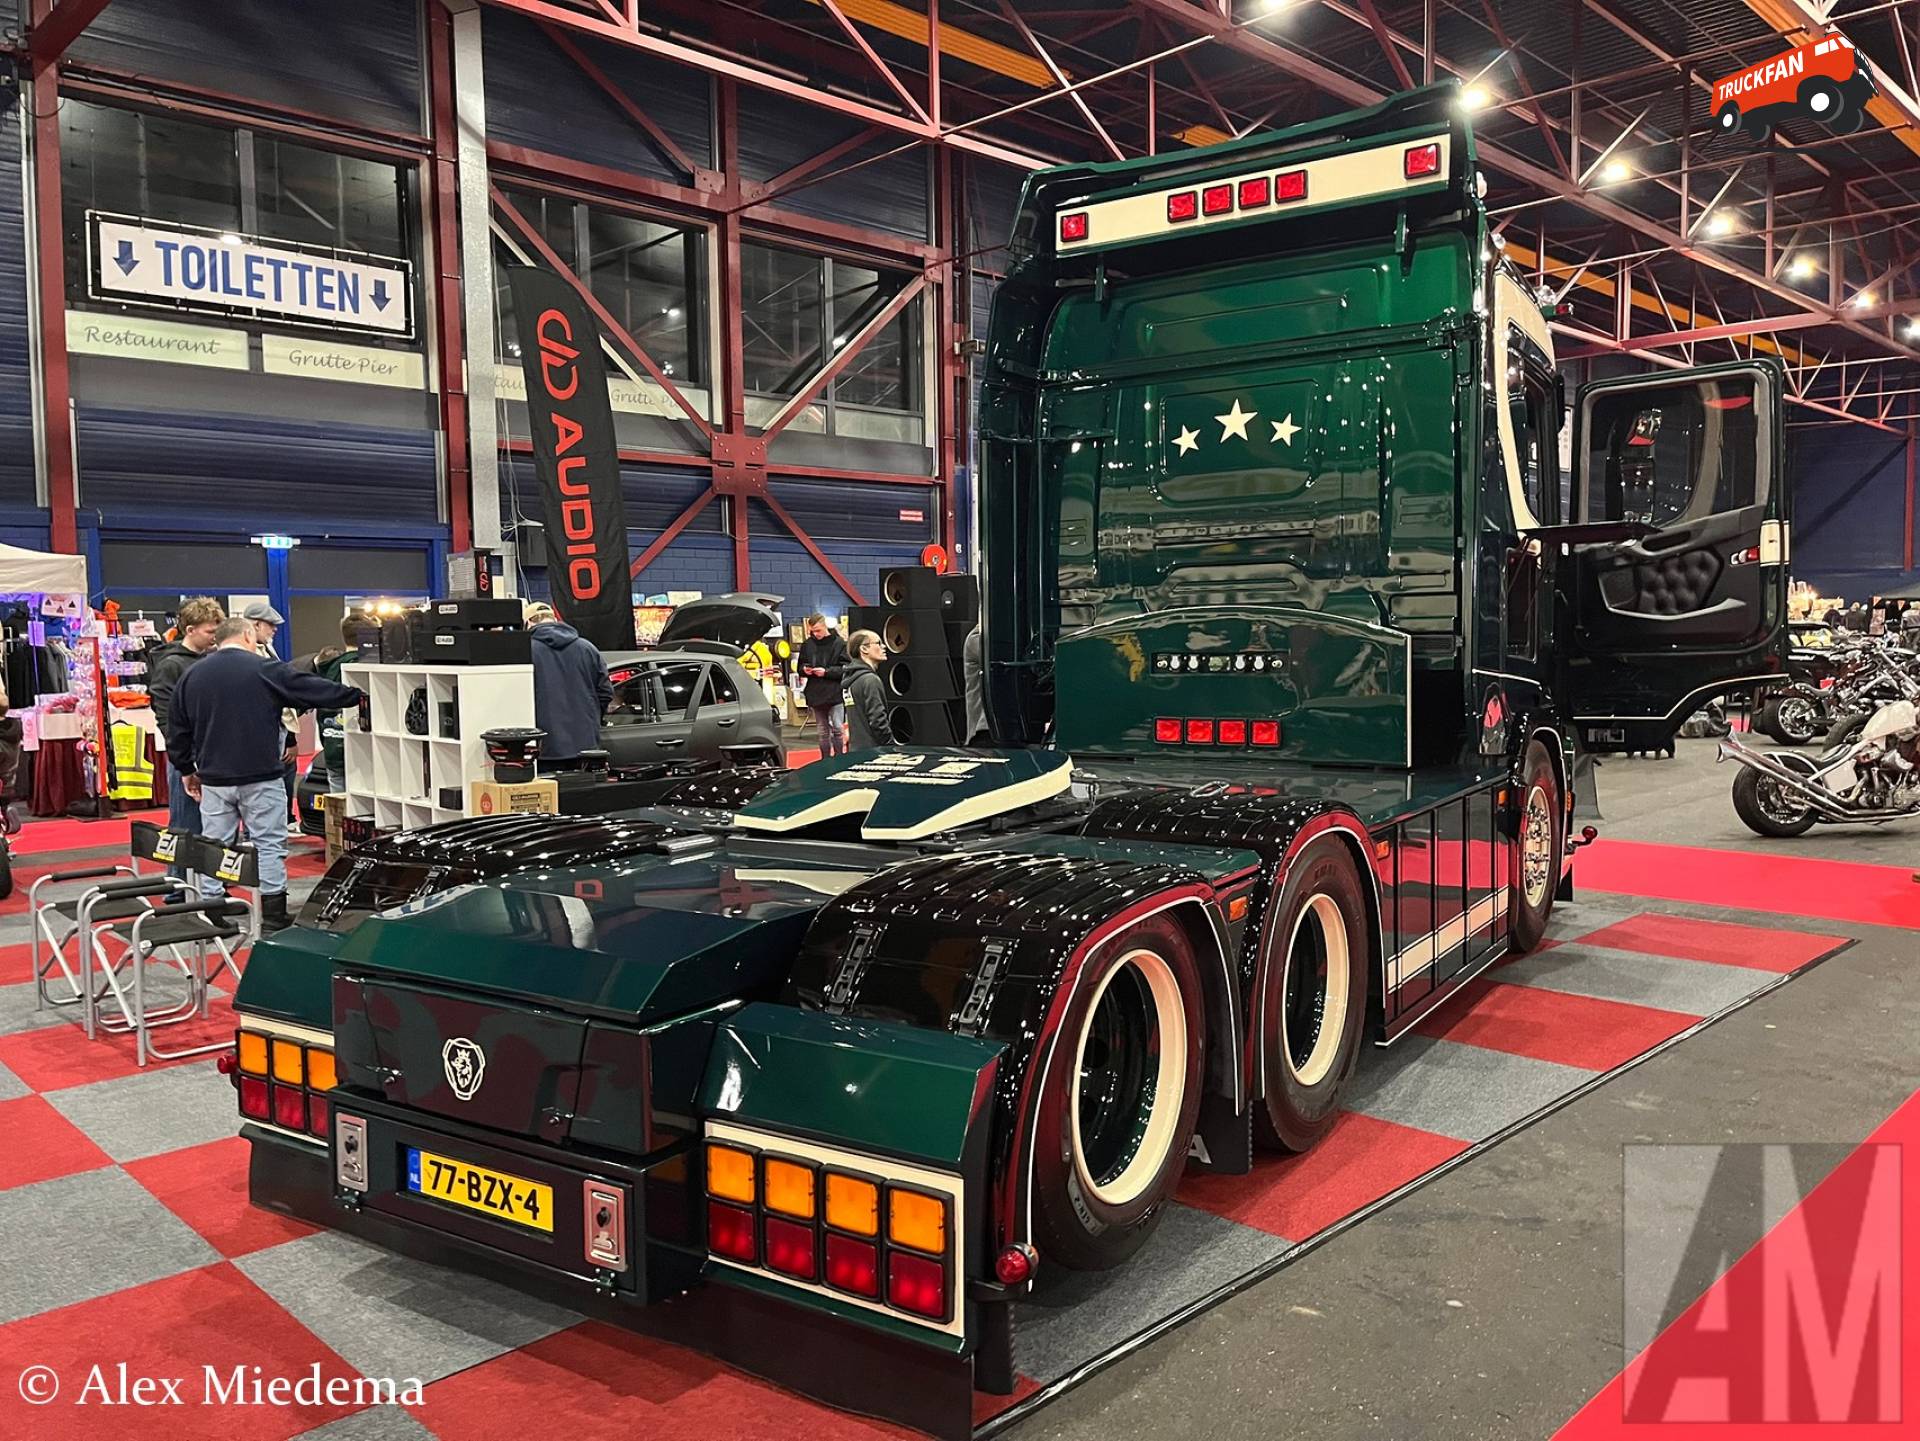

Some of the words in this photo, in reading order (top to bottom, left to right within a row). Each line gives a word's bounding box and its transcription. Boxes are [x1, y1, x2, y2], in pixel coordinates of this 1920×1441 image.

[155, 240, 359, 314] TOILETTEN
[84, 326, 221, 355] Restaurant
[288, 349, 357, 372] Grutte
[358, 357, 399, 376] Pier
[551, 411, 601, 600] AUDIO
[429, 1159, 540, 1221] 77-BZX-4
